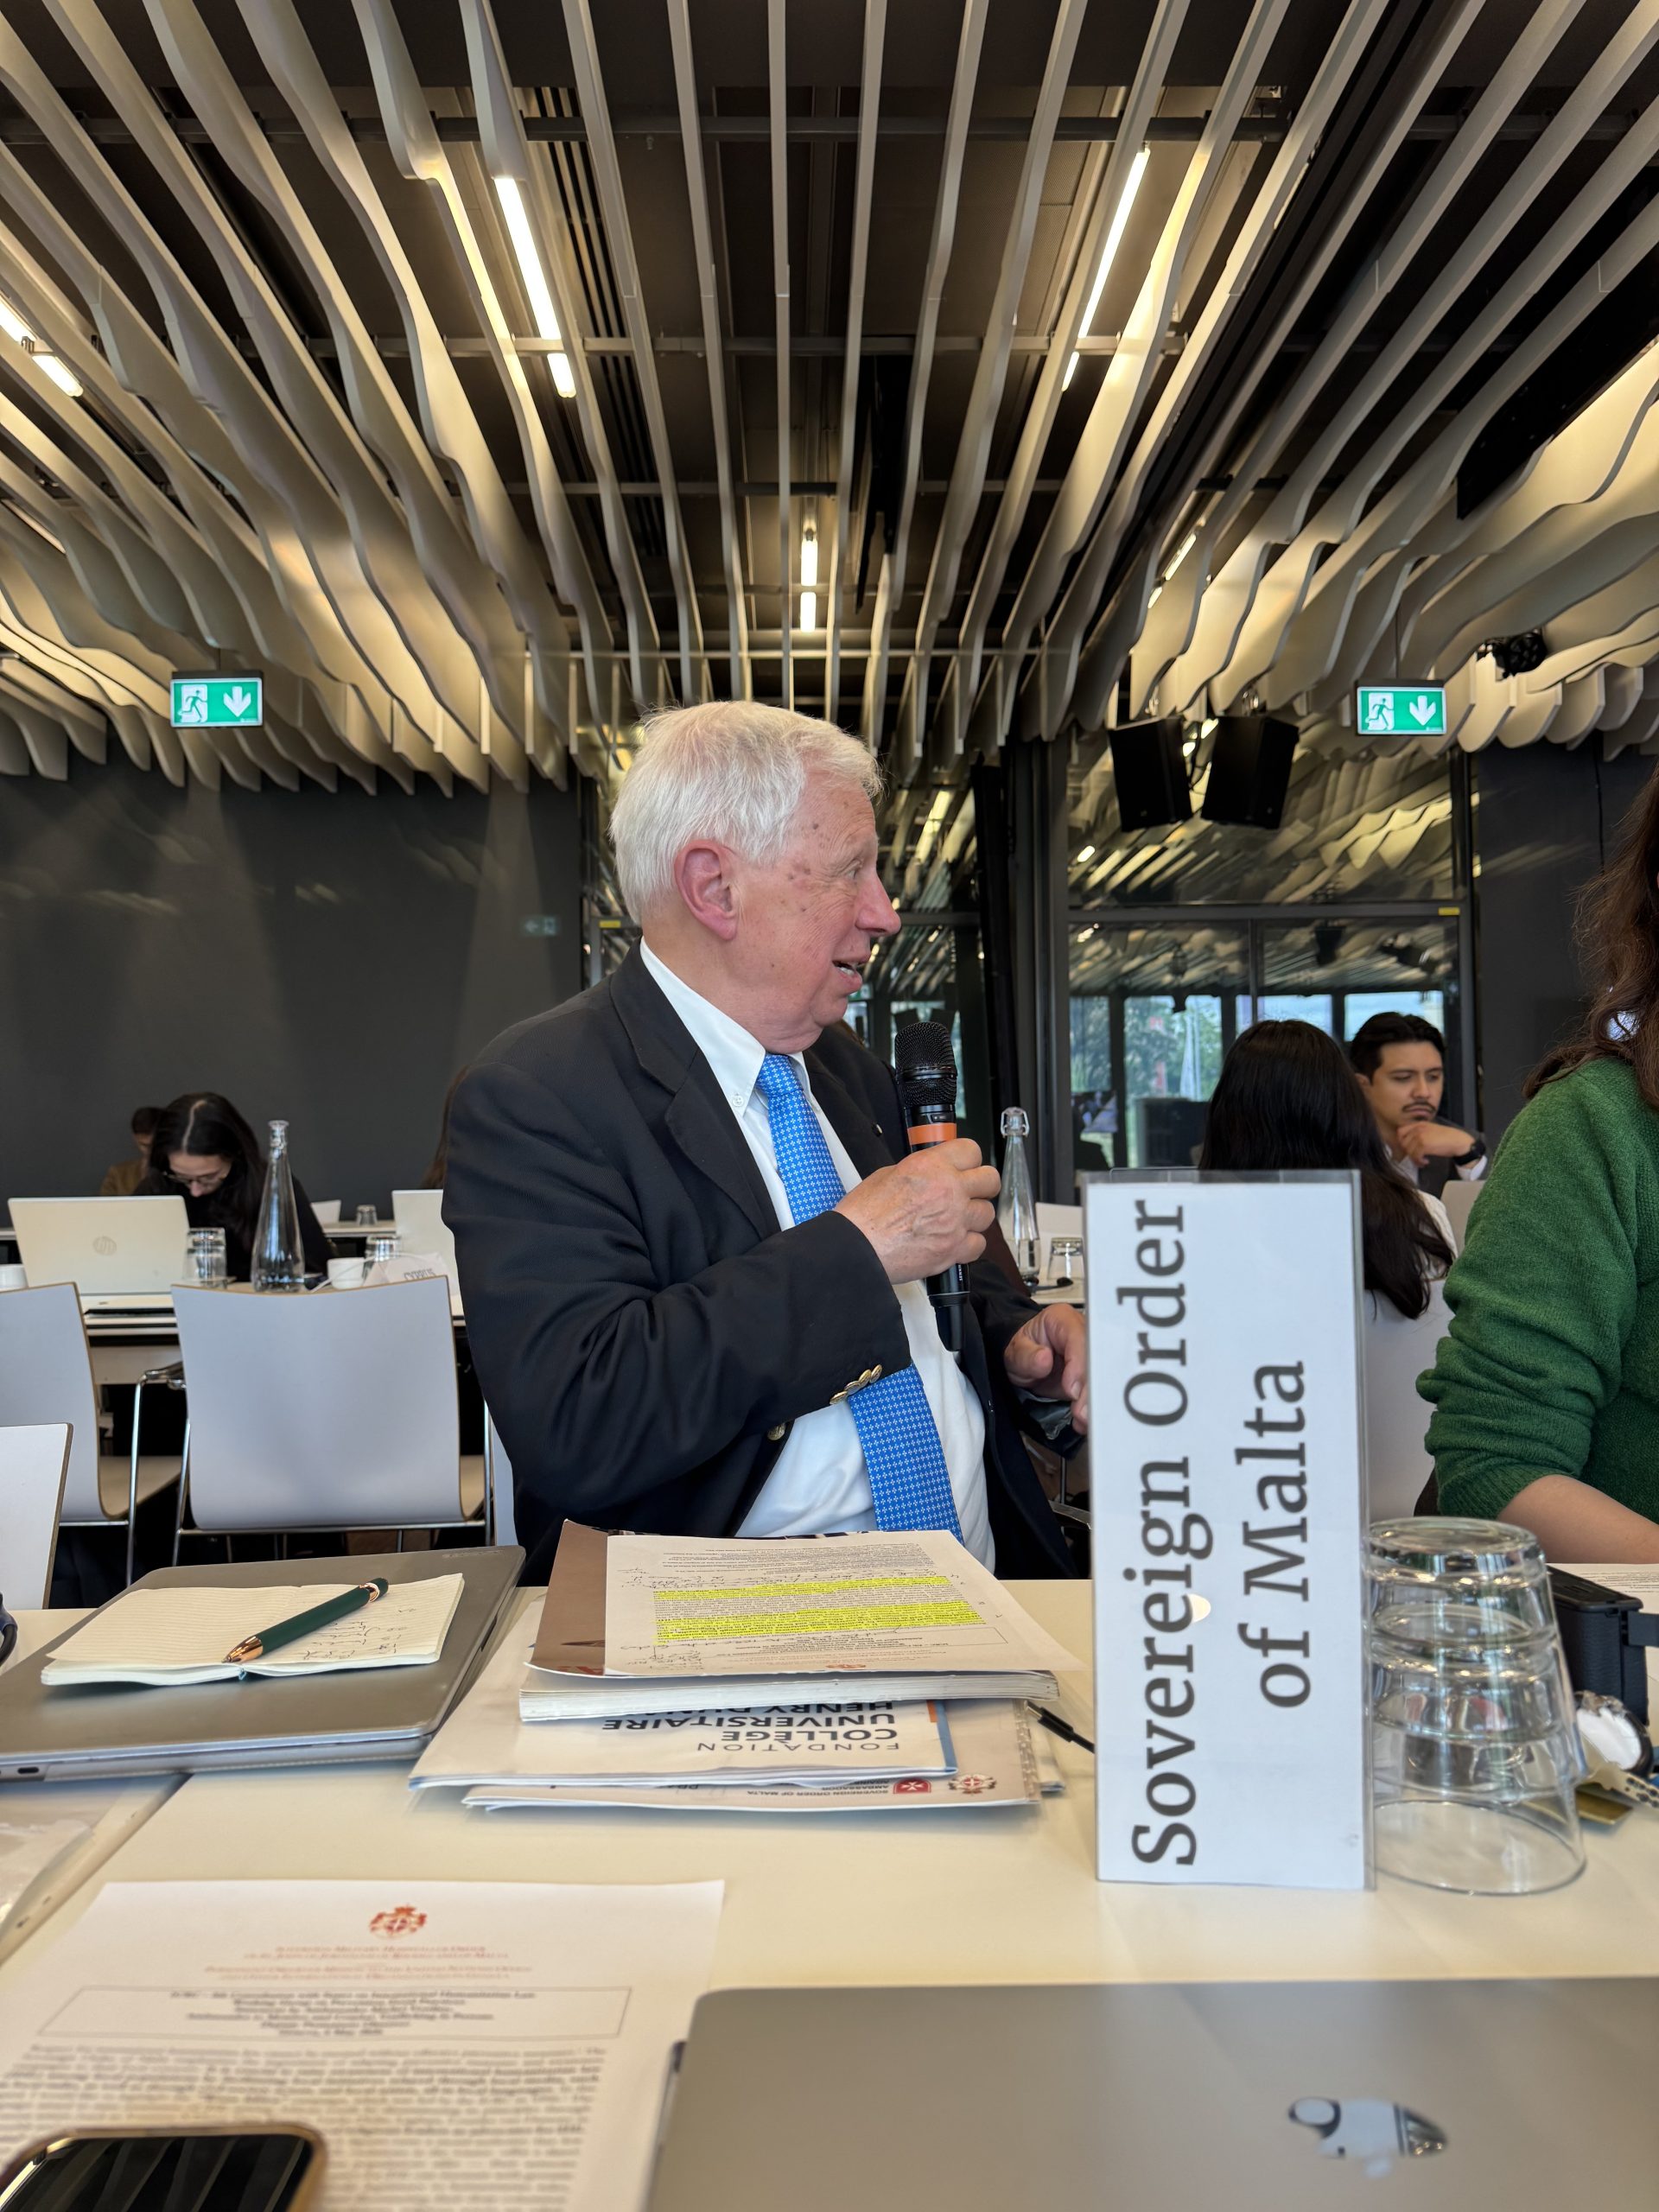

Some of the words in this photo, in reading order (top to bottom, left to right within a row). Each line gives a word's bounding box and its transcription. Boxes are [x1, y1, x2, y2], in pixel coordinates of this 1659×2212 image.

[1116, 1198, 1189, 1427] Order
[1235, 1360, 1310, 1603] Malta
[1123, 1456, 1213, 1866] Sovereign
[1237, 1623, 1312, 1709] of
[602, 1713, 895, 1730] UNIVERSITAIRE
[696, 1743, 899, 1751] FONDATION
[721, 1729, 897, 1745] COLLÈGE
